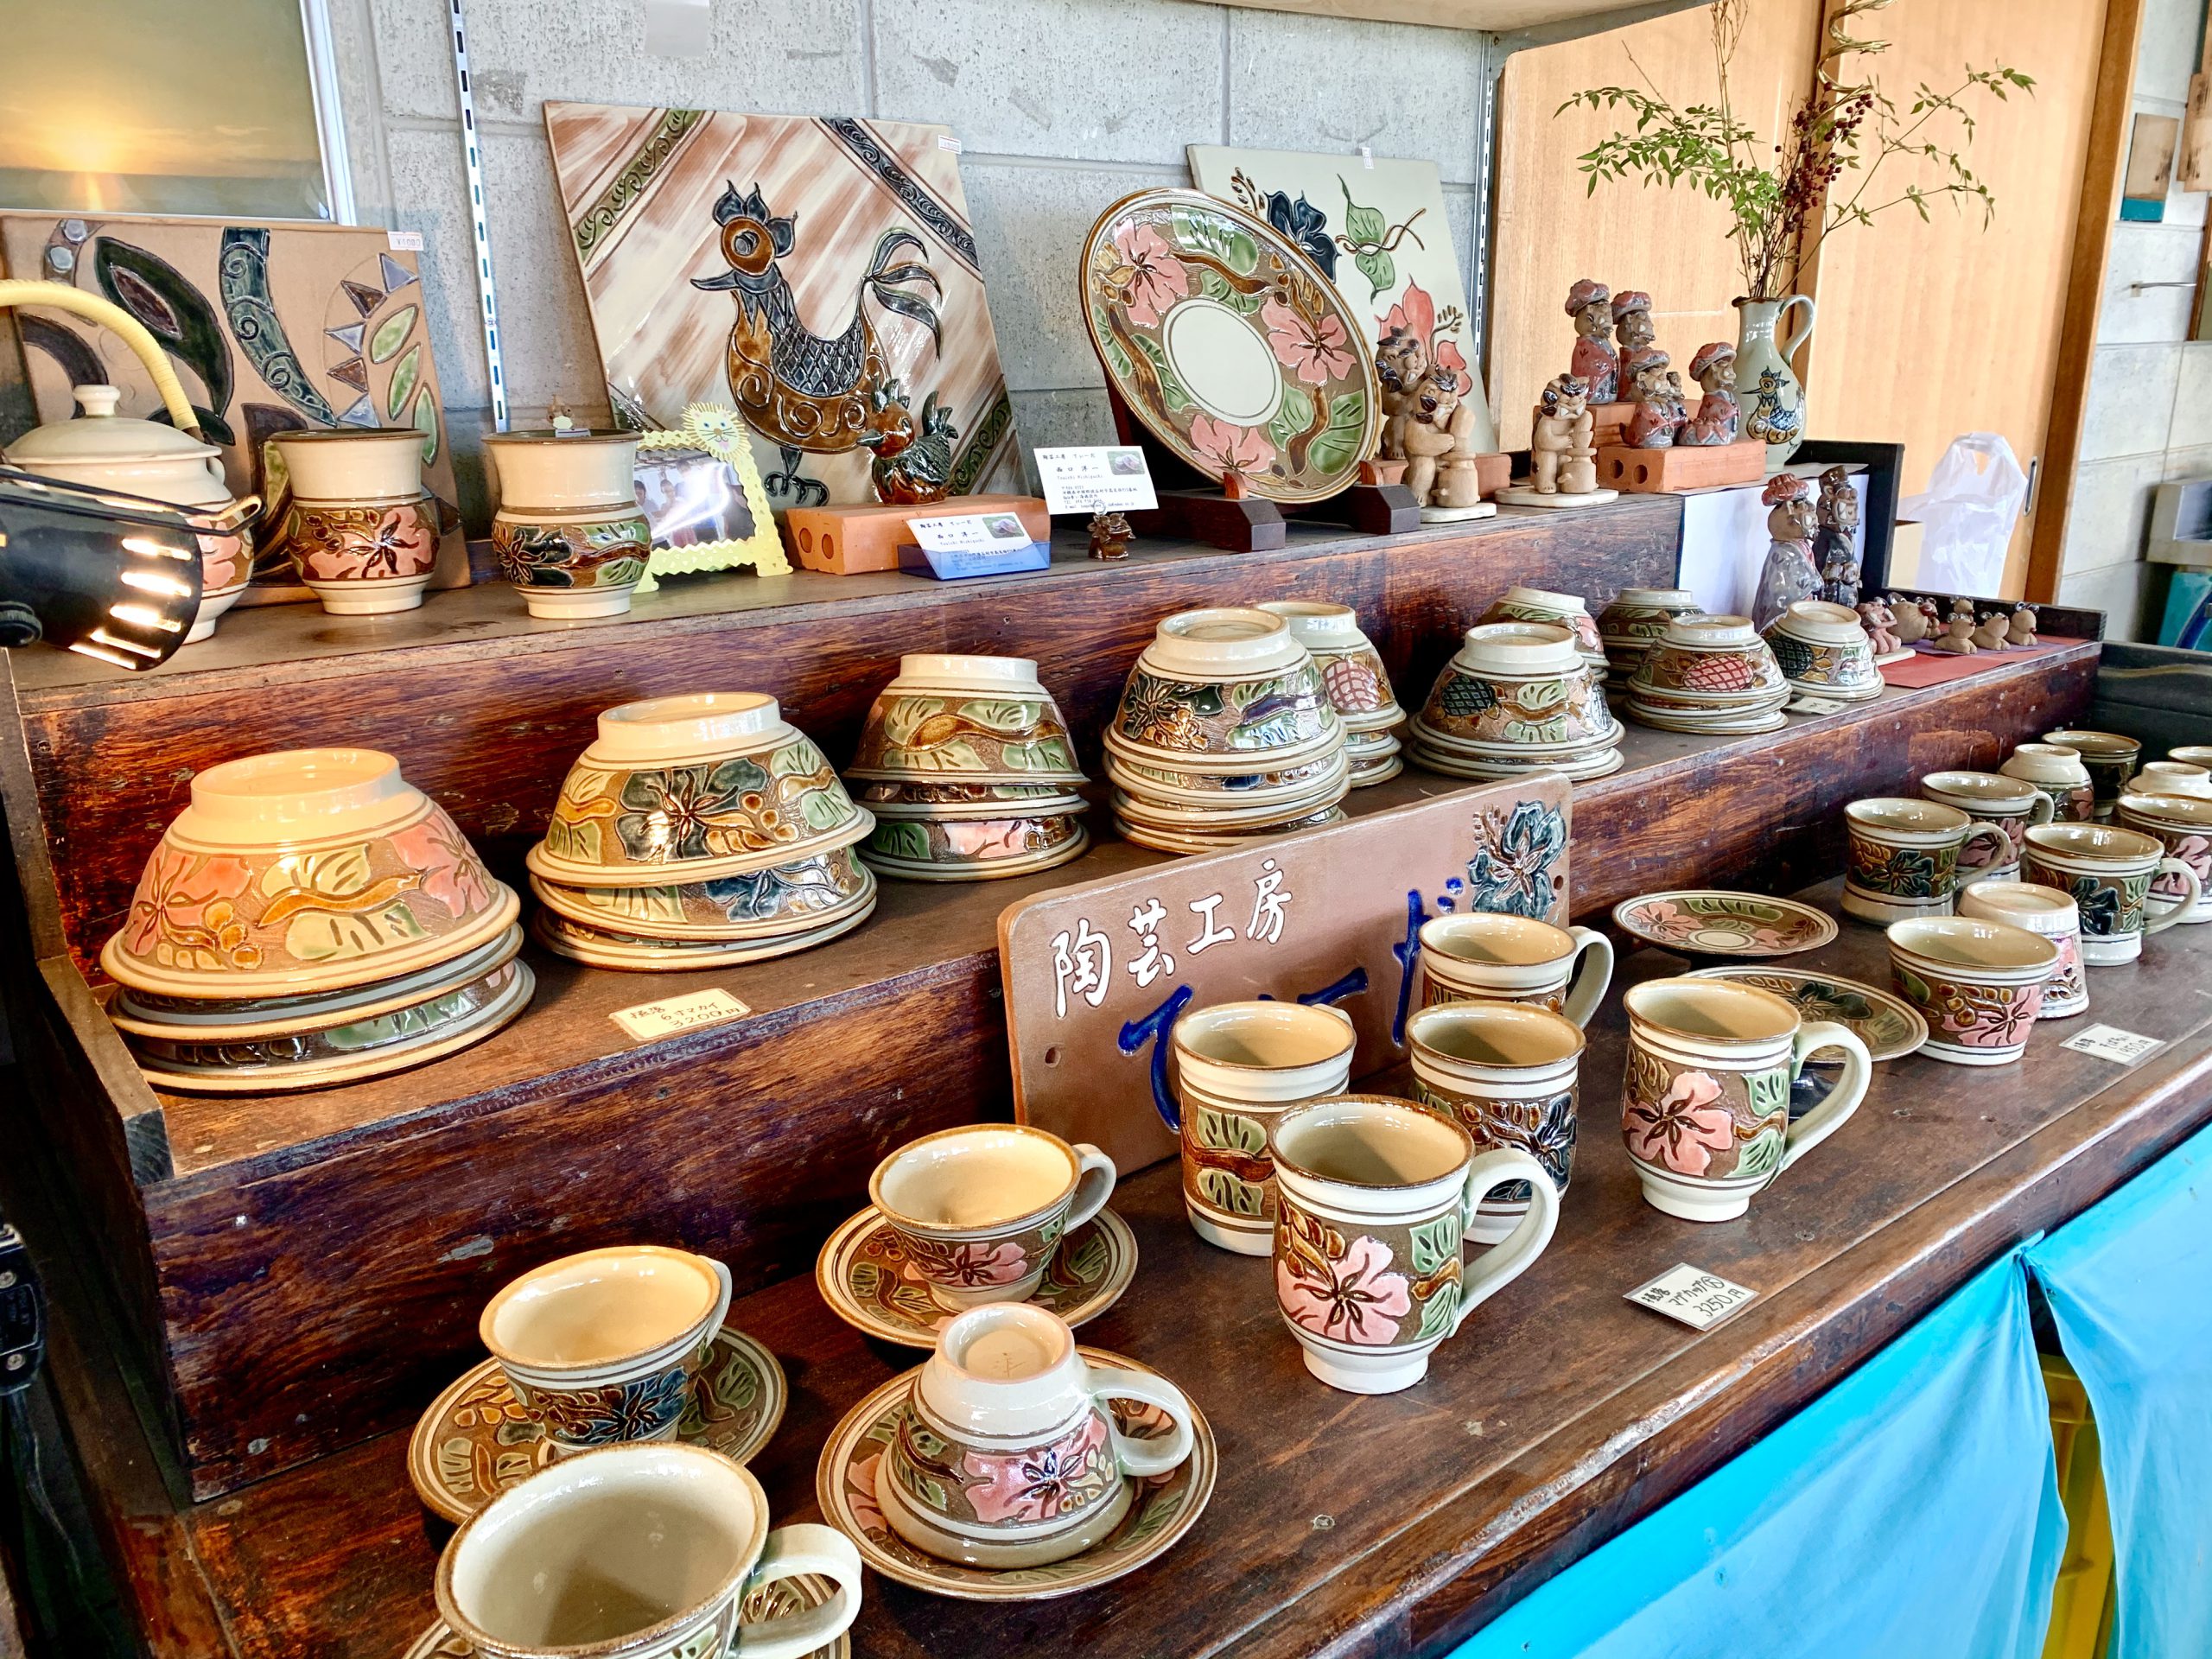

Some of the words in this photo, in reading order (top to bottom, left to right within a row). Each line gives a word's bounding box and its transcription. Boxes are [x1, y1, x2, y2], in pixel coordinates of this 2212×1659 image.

[1051, 858, 1294, 1020] 陶芸工房
[1693, 1288, 1745, 1317] 3250円
